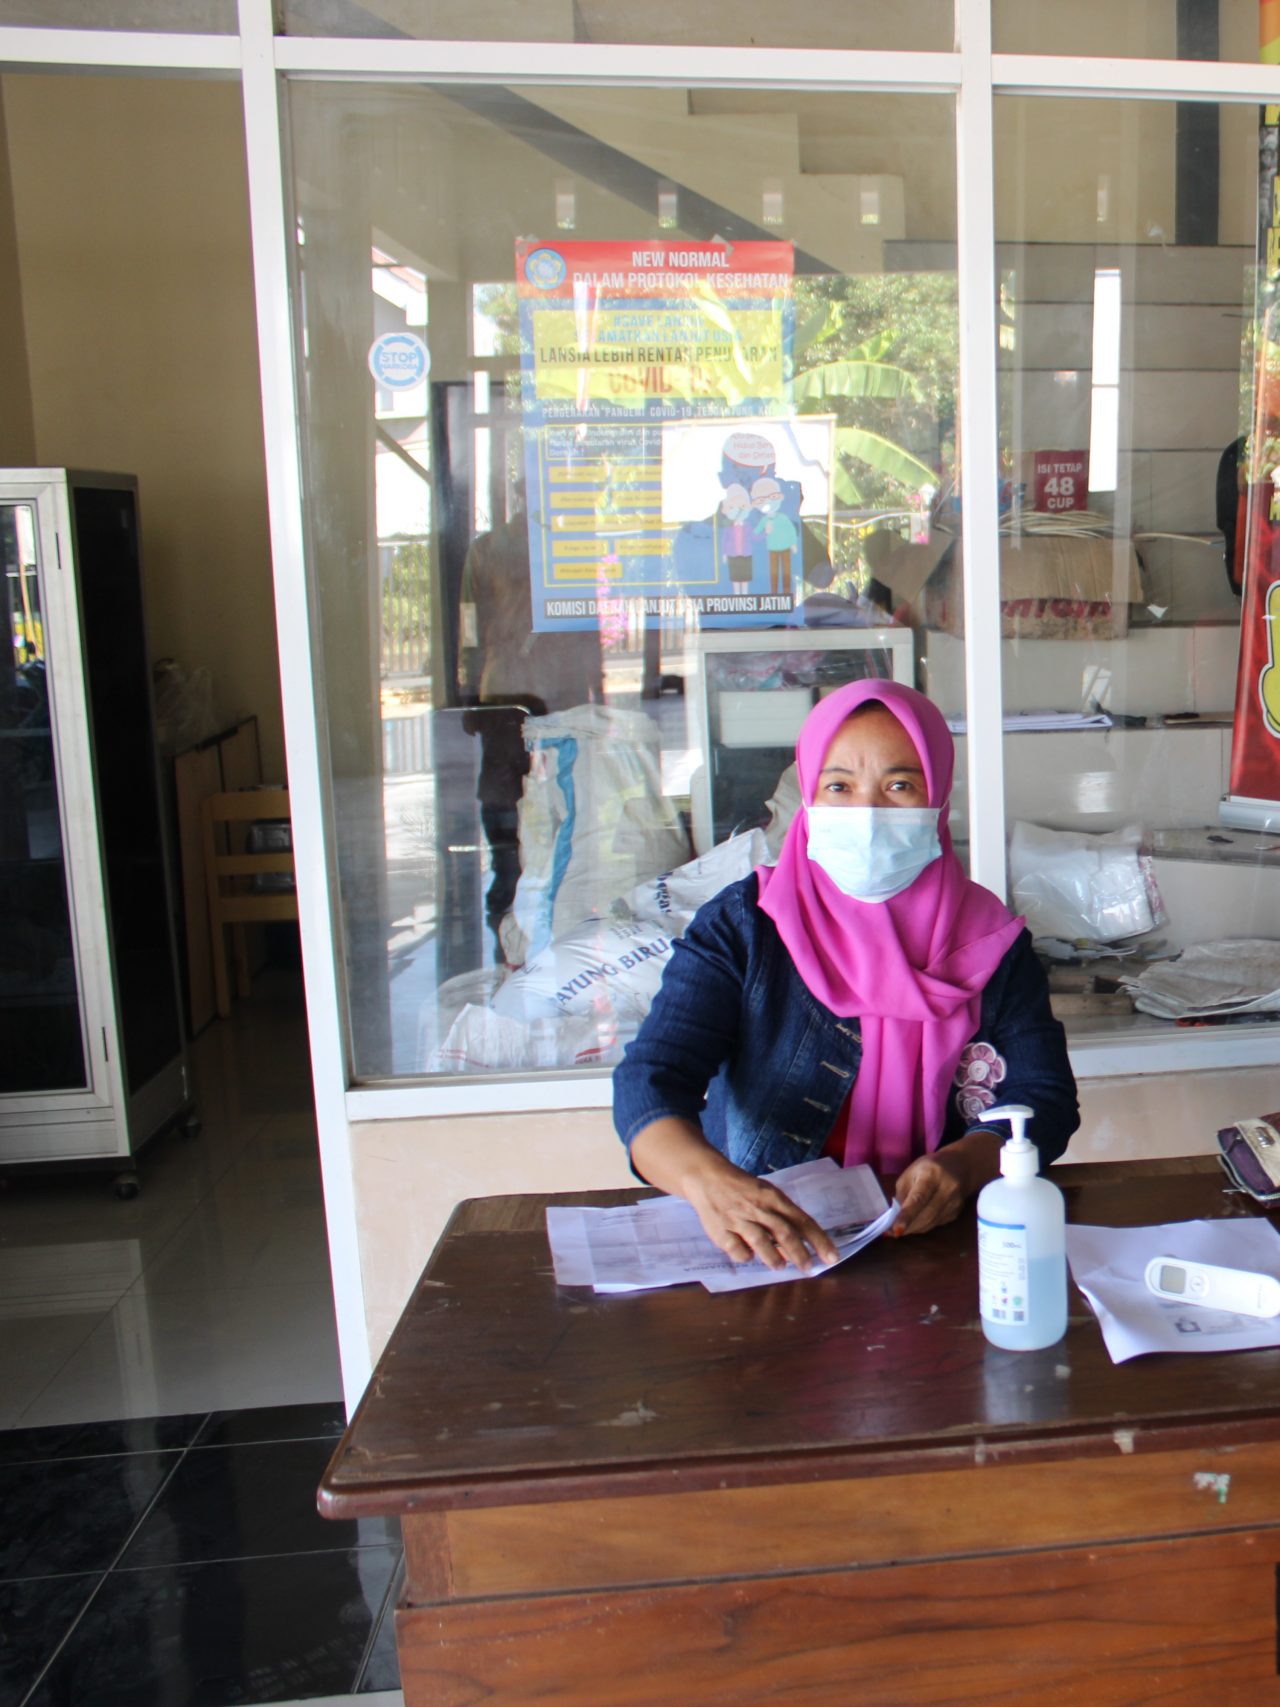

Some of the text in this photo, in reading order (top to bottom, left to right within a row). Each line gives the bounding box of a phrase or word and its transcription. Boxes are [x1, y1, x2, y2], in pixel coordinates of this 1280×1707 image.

[632, 252, 729, 267] NEW NORMAL
[573, 272, 788, 288] DALAM PROTOKOL KESEHATAN
[382, 352, 416, 363] STOP
[594, 347, 634, 362] LEBIH
[1037, 463, 1082, 473] ISI TETAP
[1044, 477, 1074, 496] 48
[1047, 498, 1074, 508] CUP
[547, 600, 586, 616] KOMISI
[707, 597, 757, 612] PROVINSI
[759, 596, 791, 611] JATIM
[553, 937, 671, 1005] AYUNG BIRU
